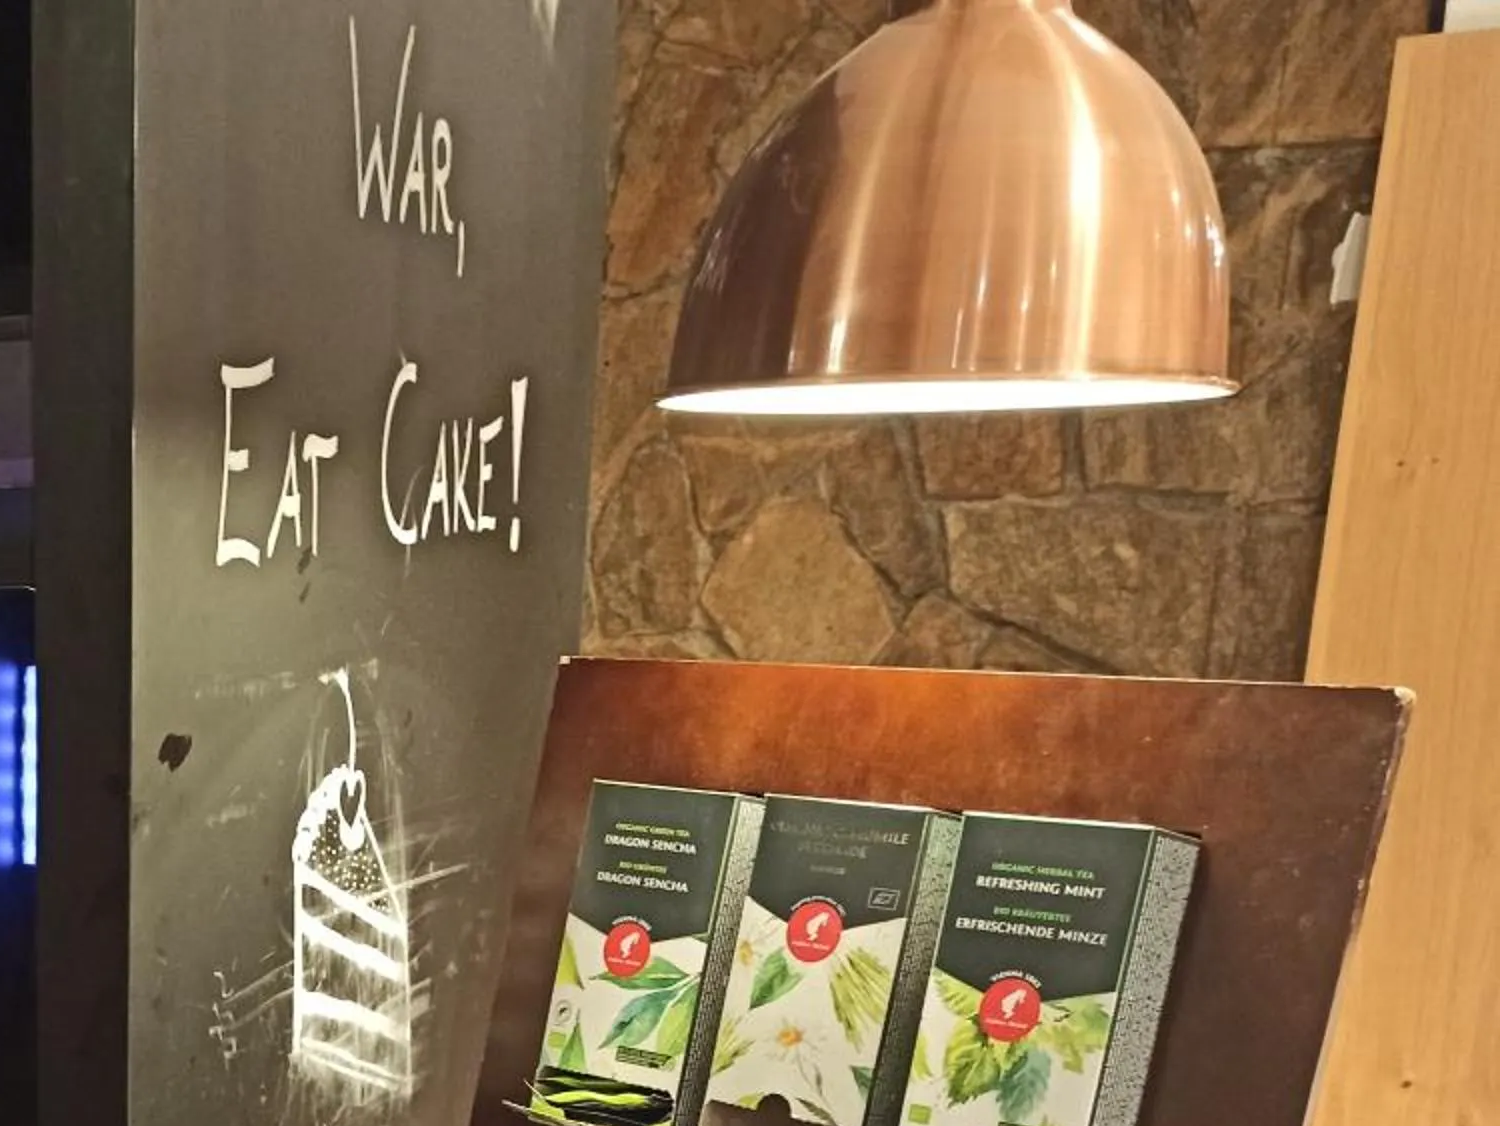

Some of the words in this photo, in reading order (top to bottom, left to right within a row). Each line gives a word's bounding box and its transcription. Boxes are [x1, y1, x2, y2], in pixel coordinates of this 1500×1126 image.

[215, 356, 339, 568] EAT
[380, 359, 530, 553] CAKE!
[604, 833, 650, 849] DRAGON
[651, 838, 697, 855] SENCHA
[597, 870, 641, 887] DRAGON
[643, 876, 690, 893] SENCHA
[975, 874, 1061, 896] REFRESHING
[1063, 882, 1106, 900] MINT
[955, 916, 1056, 940] ERFRISCHENDE
[1057, 927, 1109, 948] MINZE
